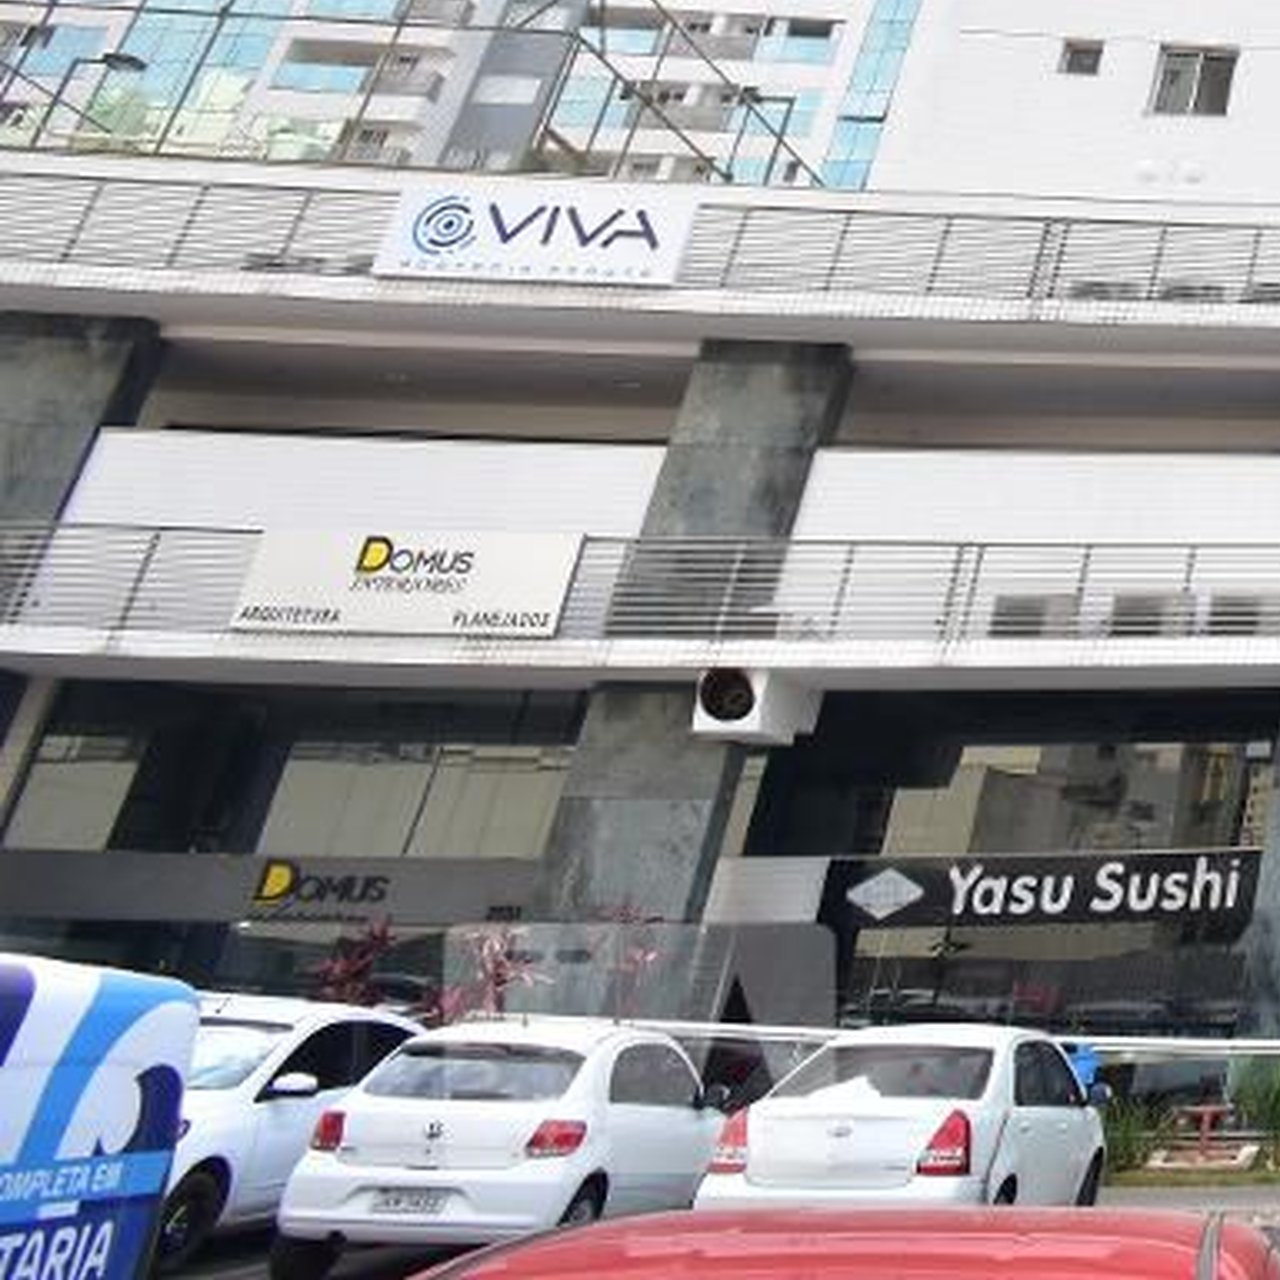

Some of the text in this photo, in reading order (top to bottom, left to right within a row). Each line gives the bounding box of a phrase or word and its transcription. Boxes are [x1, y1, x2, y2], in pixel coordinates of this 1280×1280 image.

[488, 202, 659, 250] VIVA
[355, 535, 475, 574] DOMUS
[252, 859, 391, 903] DOMUS
[948, 856, 1240, 916] Yasu Sushi
